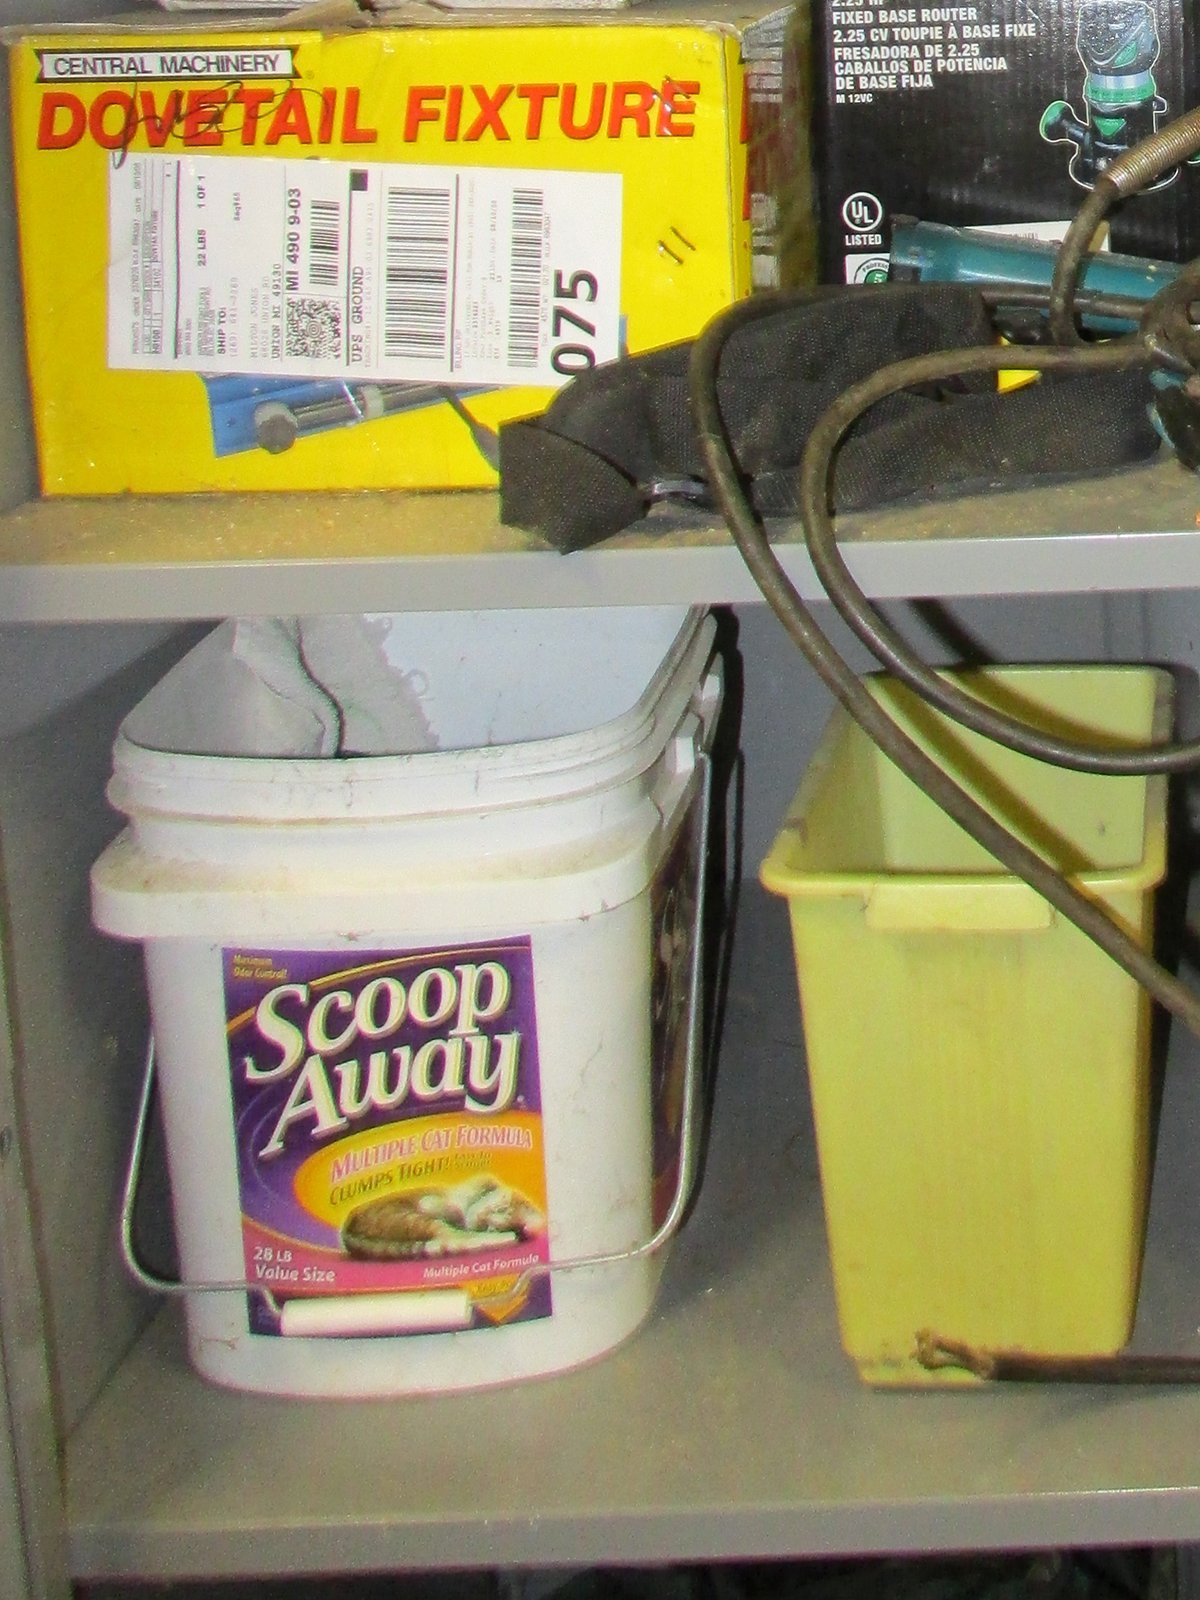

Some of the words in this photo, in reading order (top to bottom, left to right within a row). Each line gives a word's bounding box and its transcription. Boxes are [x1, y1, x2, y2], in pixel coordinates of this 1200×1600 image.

[832, 9, 874, 24] FIXED
[878, 8, 917, 23] BASE
[921, 7, 977, 22] ROUTER
[834, 28, 866, 42] 2.25
[870, 27, 890, 41] CV
[893, 25, 944, 40] TOUPIE
[948, 21, 959, 39] À
[963, 25, 1002, 39] BASE
[1006, 23, 1036, 38] FIXE
[834, 45, 920, 60] FRESADORA
[925, 45, 944, 58] DE
[948, 43, 979, 57] 2.25
[54, 54, 152, 78] CENTRAL
[160, 52, 280, 76] MACHINERY
[835, 60, 910, 75] CABALLOS
[914, 59, 932, 73] DE
[937, 57, 1007, 72] POTENCIA
[835, 76, 855, 90] DE
[860, 75, 898, 89] BASE
[901, 74, 933, 89] FIJA
[836, 95, 845, 104] M
[849, 94, 873, 104] 12VC
[38, 85, 379, 151] DOVETAIL
[403, 79, 701, 144] FIXTURE
[198, 185, 206, 199] OF
[288, 188, 300, 225] 9-03
[851, 200, 874, 226] UL
[198, 229, 206, 250] LBS
[287, 232, 299, 264] 490
[845, 234, 882, 246] LISTED
[198, 253, 206, 266] 22
[273, 264, 281, 297] 49130
[286, 271, 299, 291] MI
[352, 266, 364, 324] GROUND
[218, 307, 226, 324] TO:
[273, 305, 281, 318] MI
[550, 269, 597, 376] 075
[218, 329, 226, 354] SHIP
[272, 325, 280, 358] UNION
[352, 334, 363, 362] UPS
[244, 960, 514, 1082] Scoop
[259, 1030, 522, 1160] Away
[330, 1133, 417, 1183] MULTIPLE
[421, 1128, 451, 1151] CAT
[456, 1124, 534, 1149] FORMULA
[329, 1167, 394, 1205] CLUMPS
[398, 1157, 450, 1184] TIGHT!
[254, 1246, 273, 1260] 28
[277, 1251, 292, 1262] LB
[423, 1265, 469, 1279] Multiple
[473, 1260, 491, 1273] Cat
[494, 1253, 539, 1270] Formula
[256, 1265, 298, 1281] Value
[303, 1266, 336, 1282] Size
